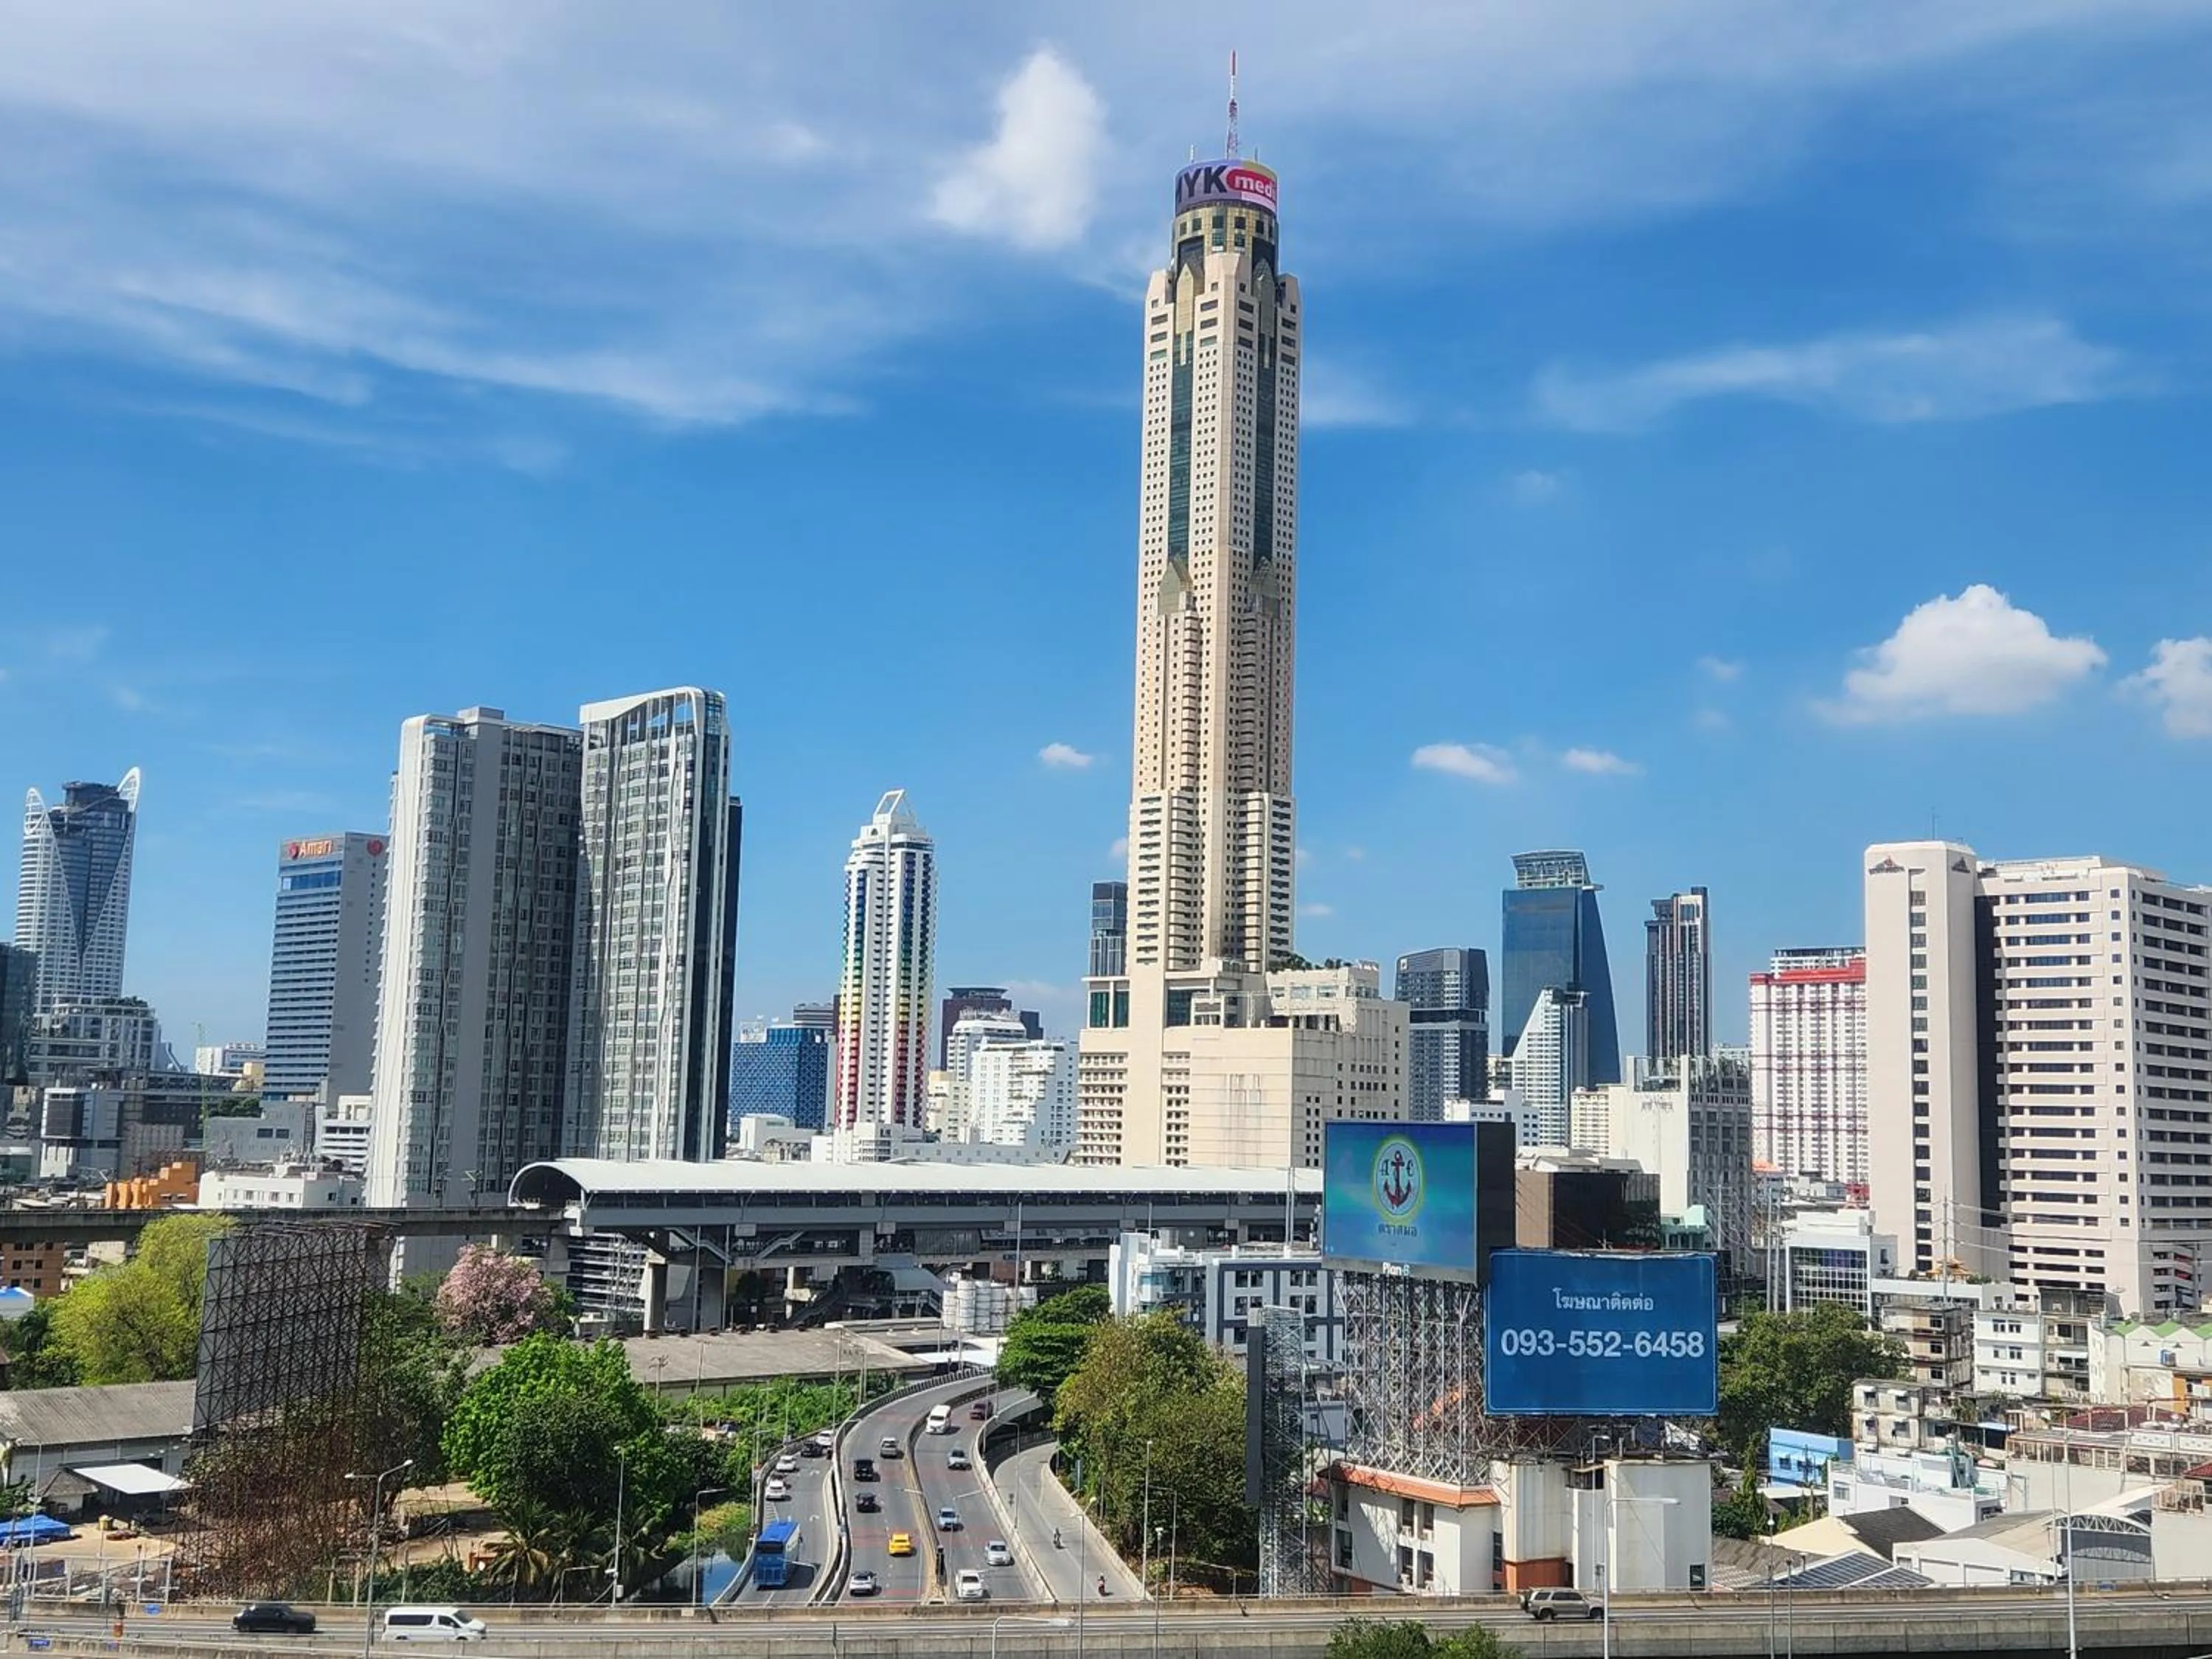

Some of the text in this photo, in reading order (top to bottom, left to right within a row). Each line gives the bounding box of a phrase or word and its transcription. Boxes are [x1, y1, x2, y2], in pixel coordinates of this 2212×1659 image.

[1553, 1287, 1654, 1311] โฆษณาติดต่อ
[1500, 1328, 1705, 1358] 093-552-6458
